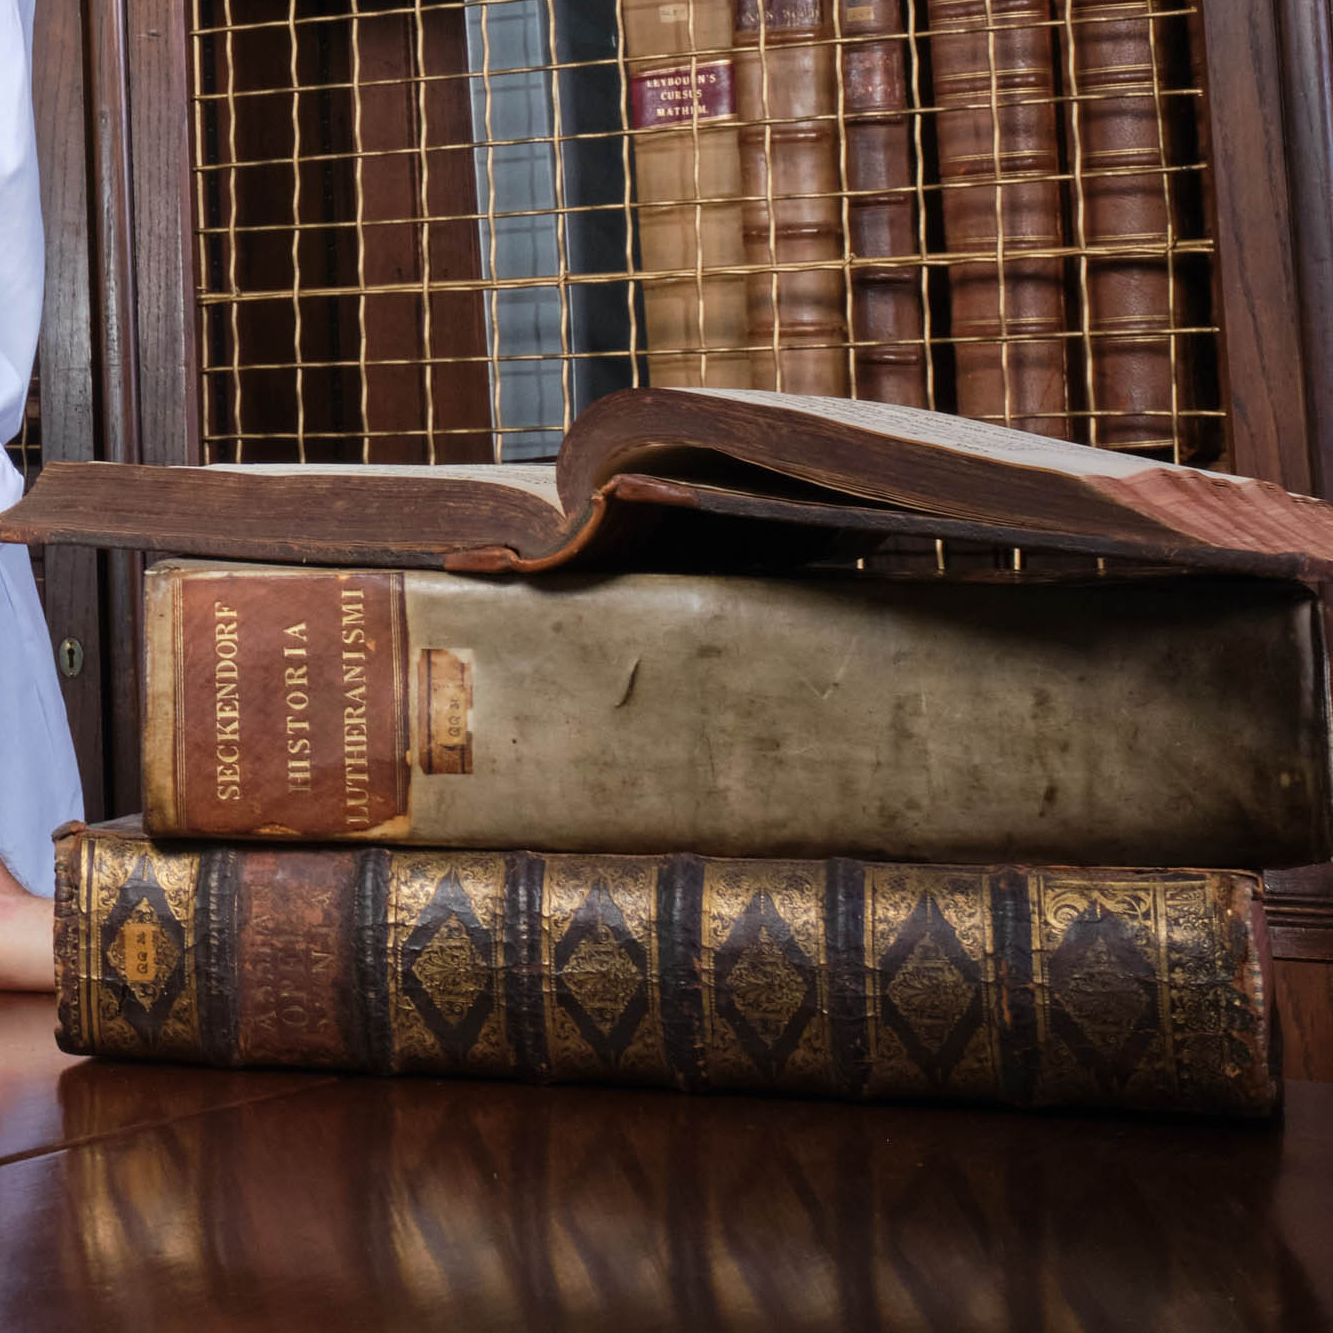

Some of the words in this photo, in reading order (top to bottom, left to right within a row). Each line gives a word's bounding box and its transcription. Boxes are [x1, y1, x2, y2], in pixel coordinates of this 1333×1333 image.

[645, 72, 717, 89] LEYBOUN'S
[215, 601, 241, 801] SECKENDORF
[283, 621, 313, 794] HISTORIA
[340, 588, 371, 826] LUTHERANISMI
